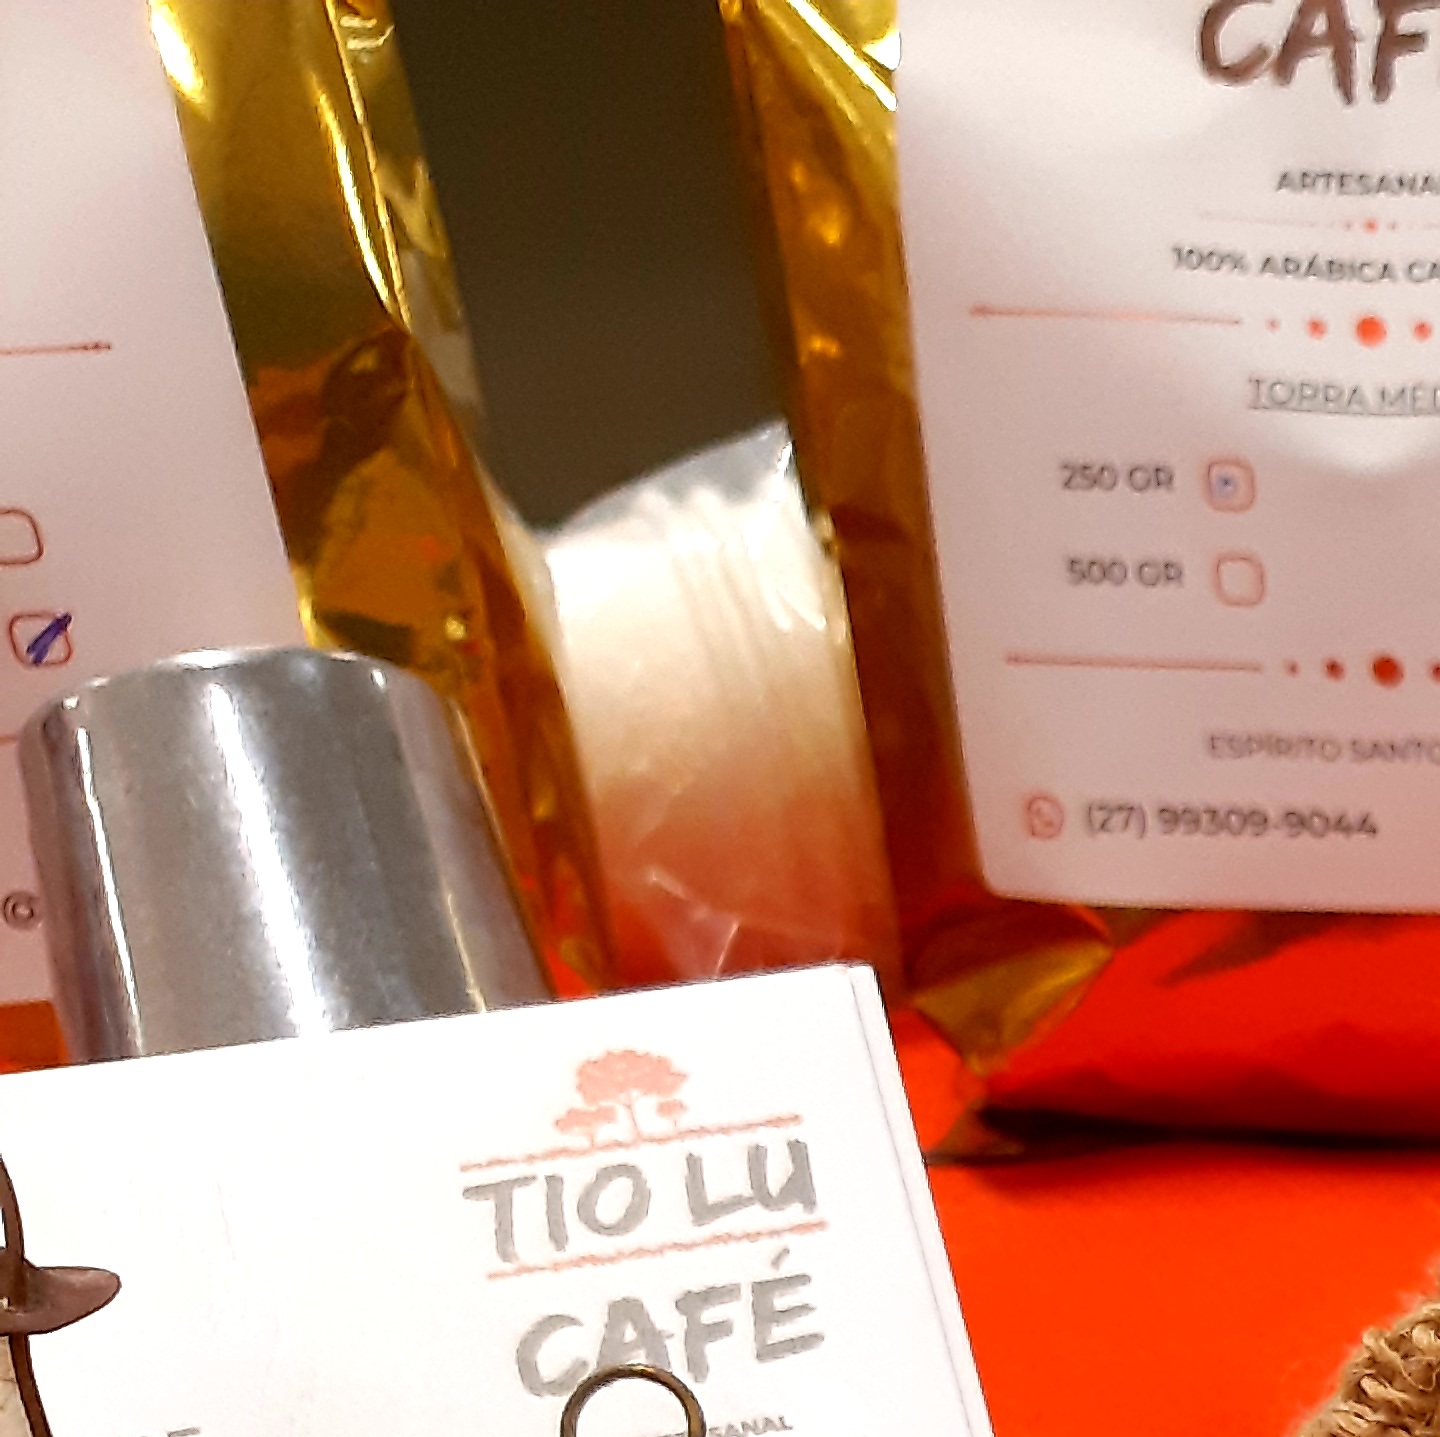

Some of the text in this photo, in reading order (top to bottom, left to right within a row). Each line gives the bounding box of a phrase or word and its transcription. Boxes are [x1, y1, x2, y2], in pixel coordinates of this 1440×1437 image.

[1172, 246, 1248, 275] 100%
[1259, 251, 1401, 284] ARÁBICA
[1247, 378, 1363, 412] TORRA
[1061, 462, 1175, 494] 250 GR
[1067, 556, 1183, 588] 500 GR
[1207, 733, 1343, 763] ESPÍRITO
[1085, 803, 1379, 840] (27) 99309-9044
[463, 1138, 818, 1264] TIO LU
[516, 1247, 825, 1398] CAFÉ
